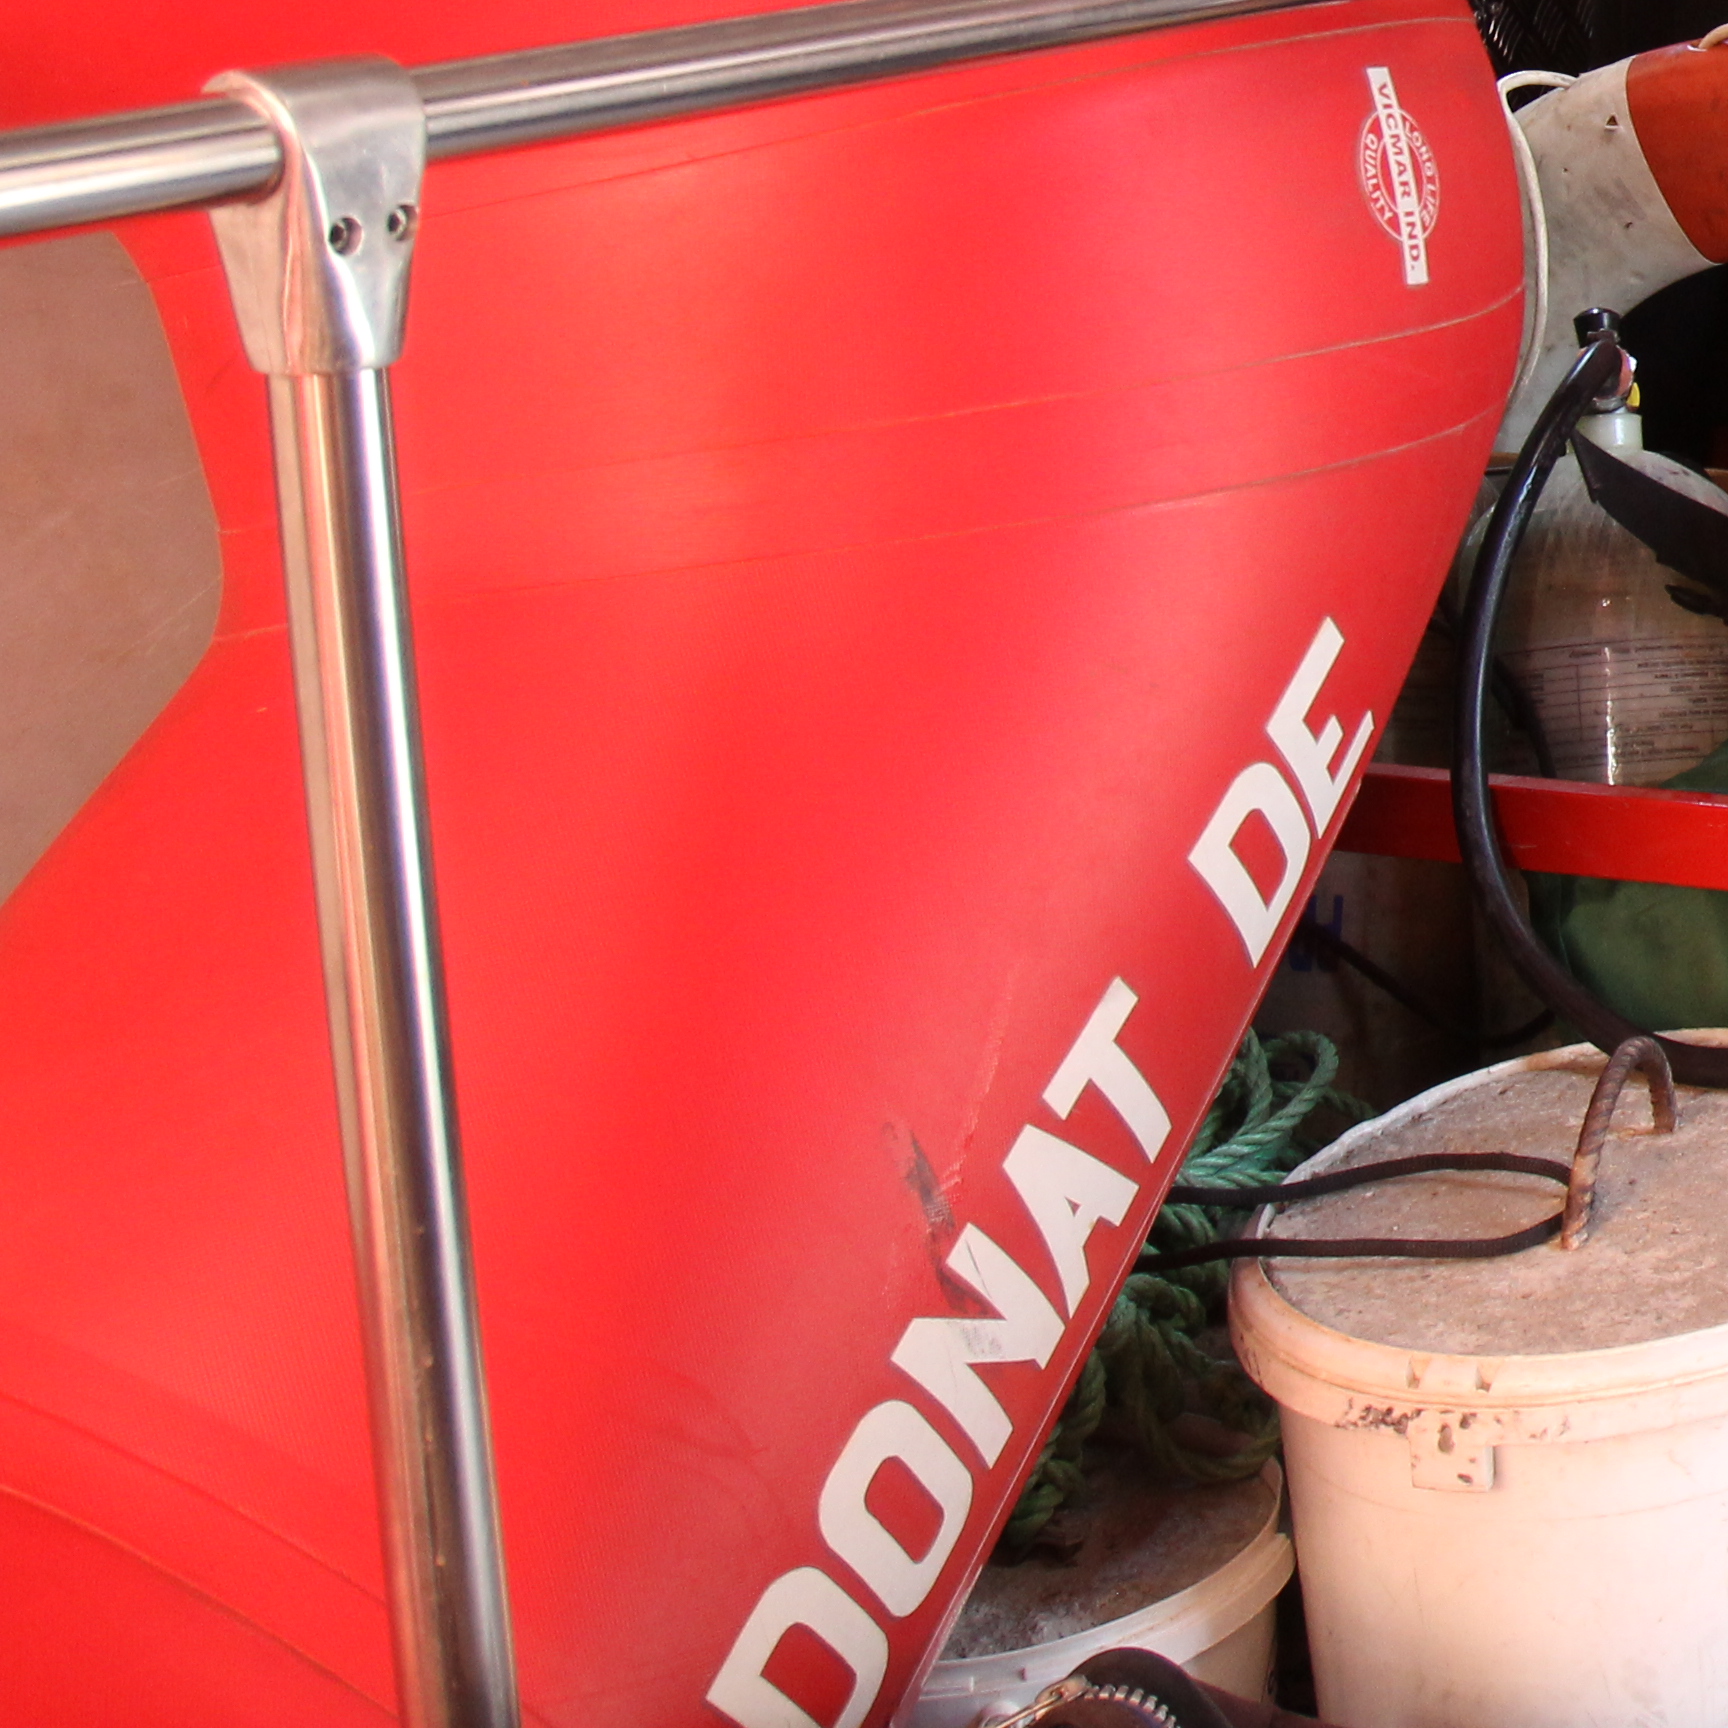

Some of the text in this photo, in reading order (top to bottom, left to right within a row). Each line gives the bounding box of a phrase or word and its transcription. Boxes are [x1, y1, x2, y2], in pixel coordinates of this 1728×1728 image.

[1363, 132, 1394, 223] QUALITY
[1376, 82, 1413, 199] VICMAR
[1403, 120, 1438, 228] LONG LIFE
[705, 615, 1376, 1728] DONAT DE
